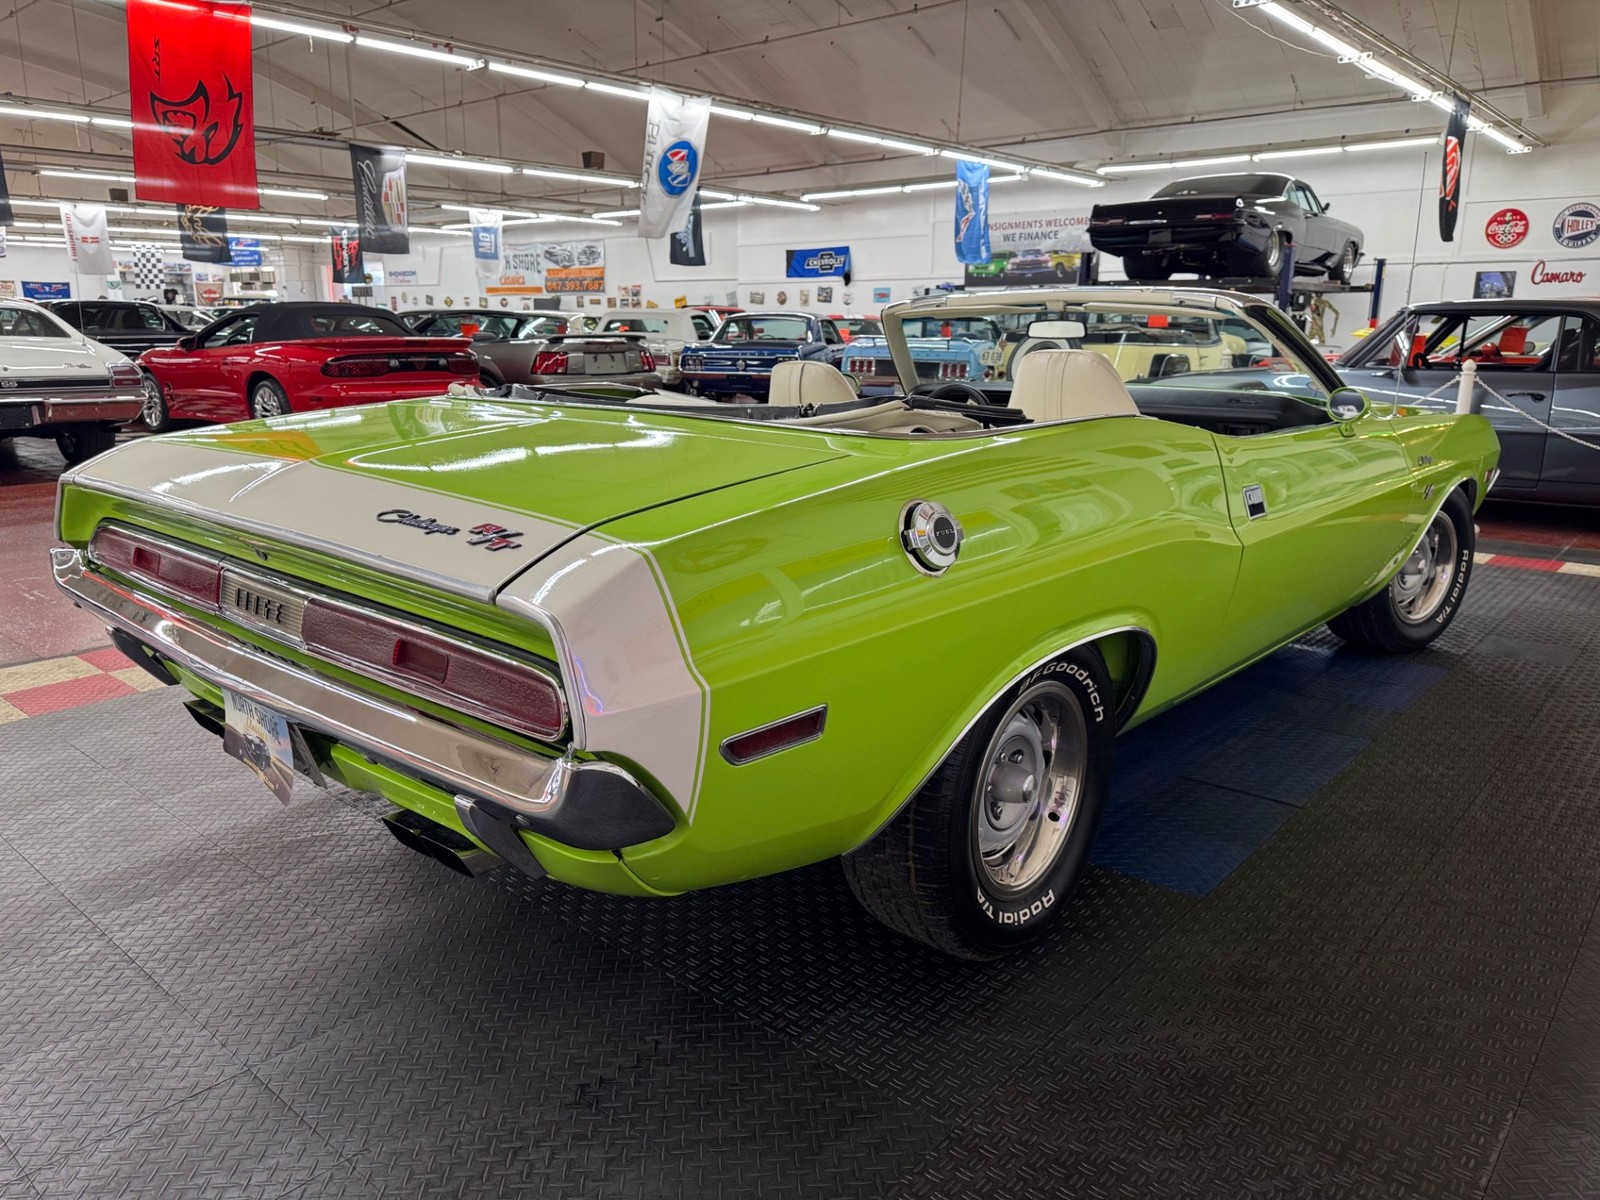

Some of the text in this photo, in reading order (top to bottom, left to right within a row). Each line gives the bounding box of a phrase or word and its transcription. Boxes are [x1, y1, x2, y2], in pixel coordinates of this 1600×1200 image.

[152, 34, 160, 81] SRT
[357, 159, 376, 240] Cadillac
[988, 216, 1089, 231] NSIGNMENTS WELCOME
[1003, 230, 1059, 242] WE FINANCE
[1566, 218, 1594, 234] HOLLEY
[513, 253, 541, 274] SHORE
[1531, 259, 1586, 285] Camaro
[466, 523, 524, 551] R/T
[936, 528, 954, 537] FUEL
[1436, 550, 1469, 624] Radial T/A
[1018, 661, 1105, 722] BFGoodrich
[977, 886, 1056, 926] Radial T/A
